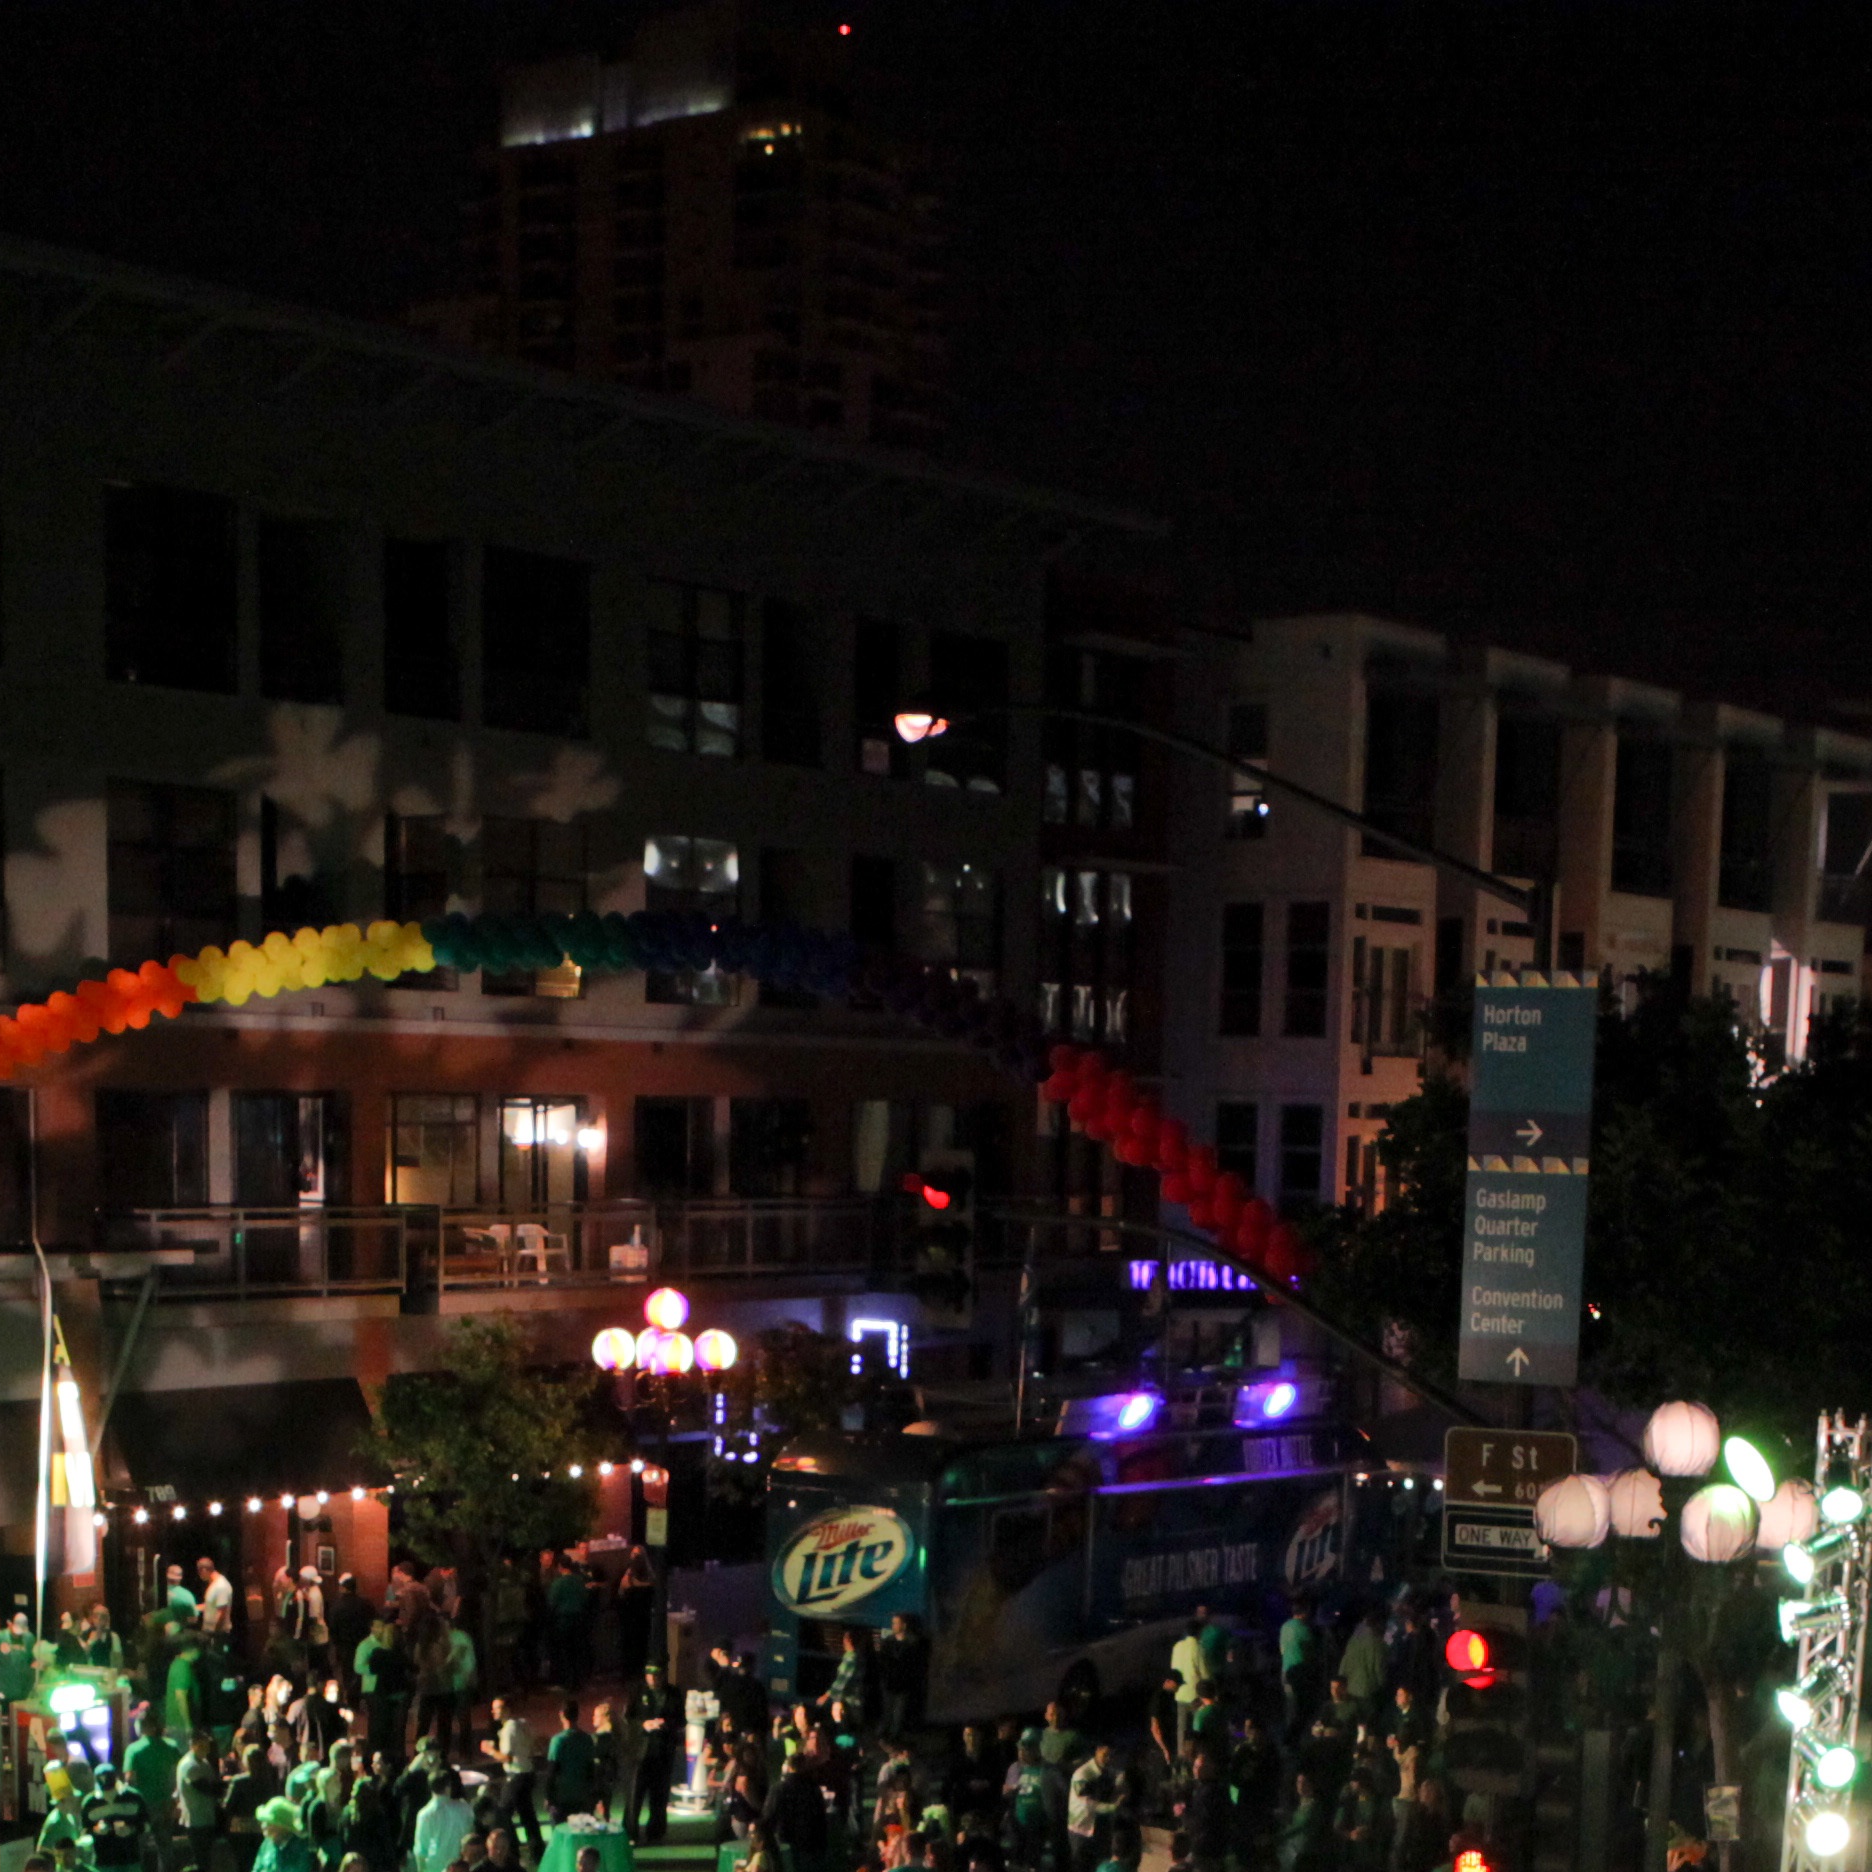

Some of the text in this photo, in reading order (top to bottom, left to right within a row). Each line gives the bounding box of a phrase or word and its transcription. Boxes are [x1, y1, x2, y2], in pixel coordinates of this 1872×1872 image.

[1483, 1004, 1542, 1026] Horton
[1482, 1031, 1527, 1052] Plaza
[1476, 1187, 1547, 1215] Gaslamp
[1474, 1215, 1539, 1237] Quarter
[1473, 1241, 1535, 1268] Parking
[1472, 1285, 1564, 1310] Convention
[1470, 1311, 1525, 1335] Center
[1482, 1443, 1539, 1471] F St
[1514, 1482, 1542, 1499] 60
[809, 1521, 876, 1551] Miller
[1458, 1525, 1533, 1547] ONE WAY
[796, 1539, 894, 1605] Lite
[28, 1717, 48, 1814] ATM
